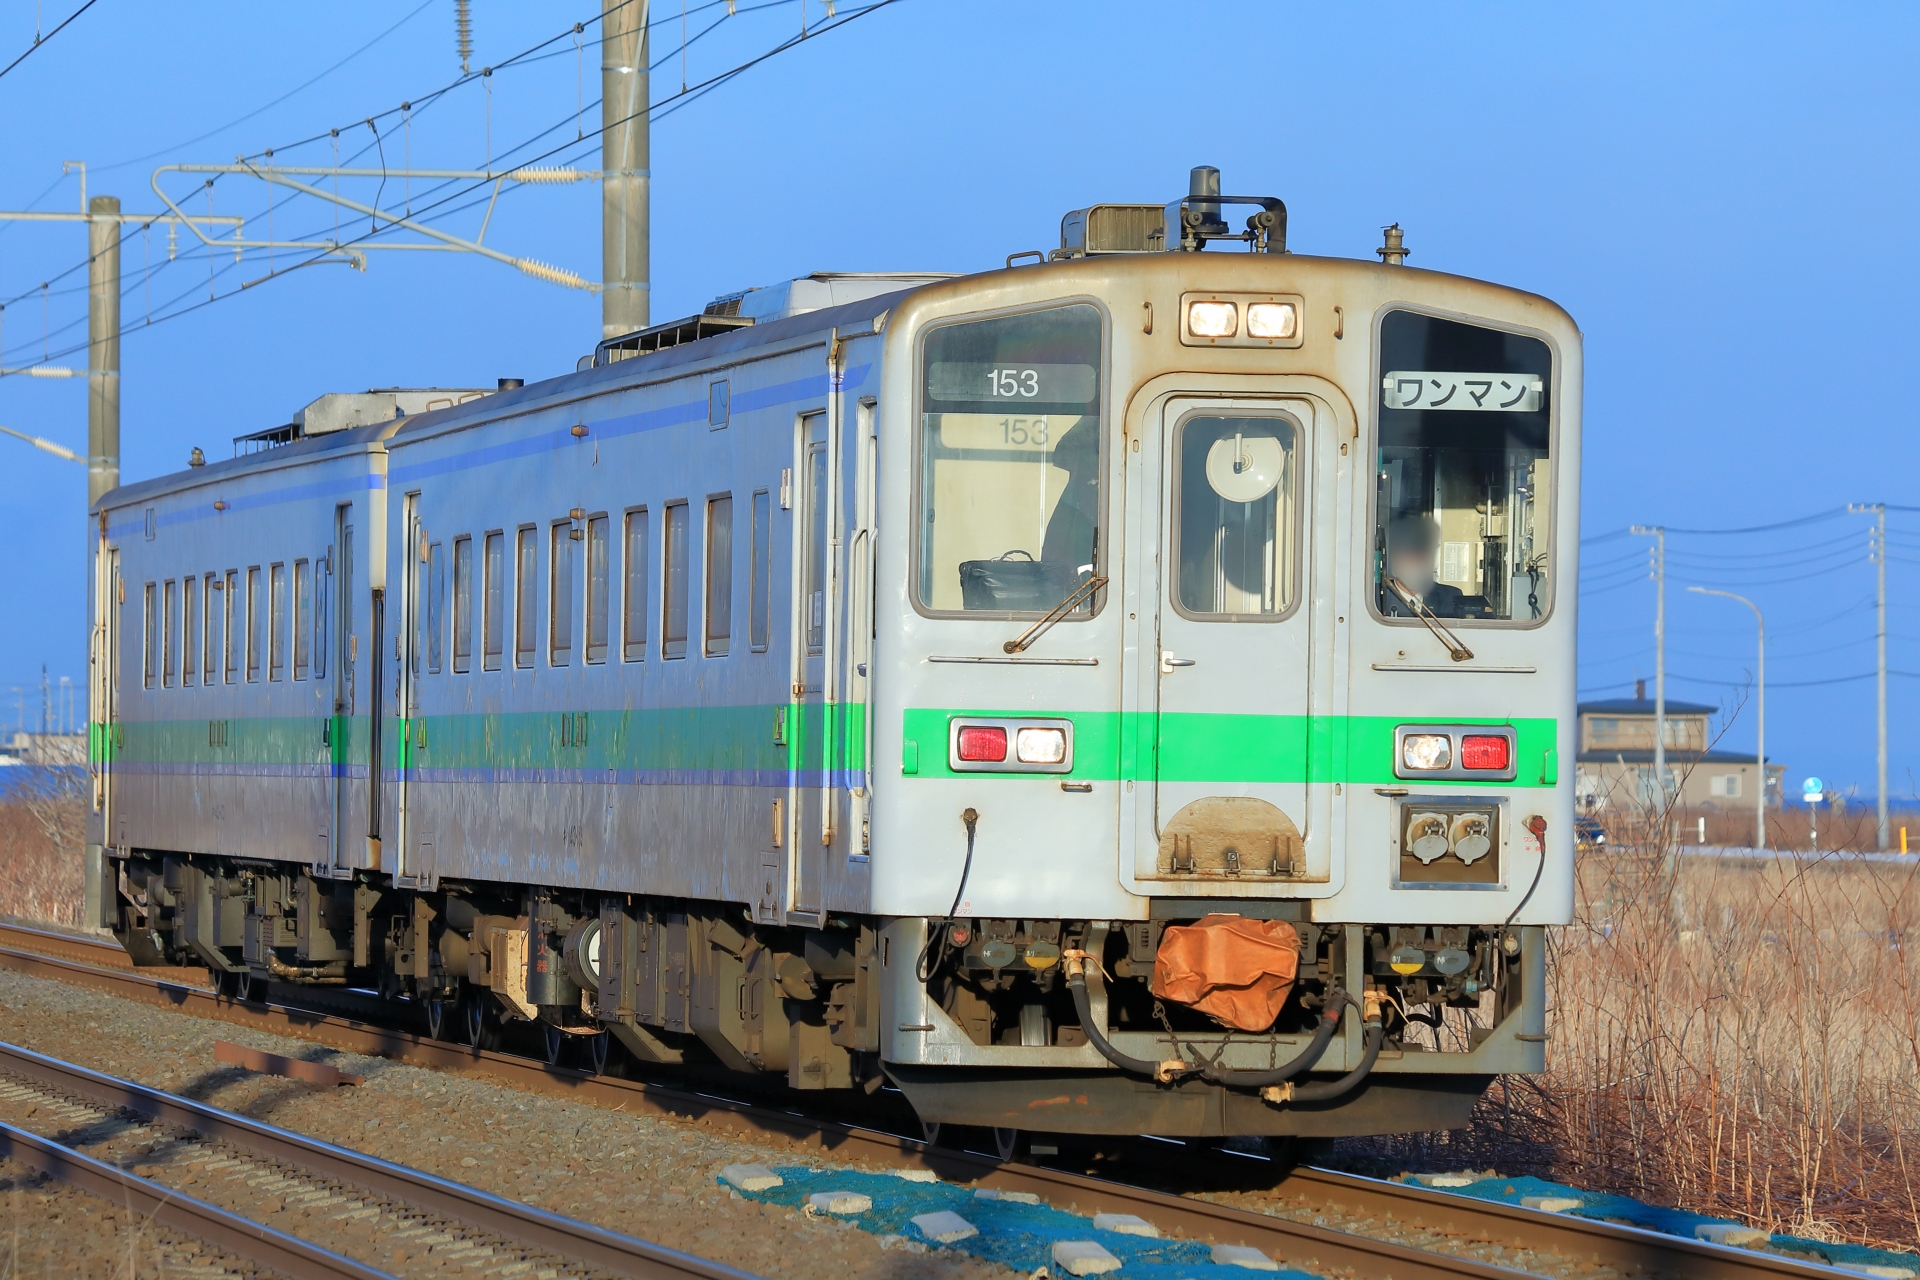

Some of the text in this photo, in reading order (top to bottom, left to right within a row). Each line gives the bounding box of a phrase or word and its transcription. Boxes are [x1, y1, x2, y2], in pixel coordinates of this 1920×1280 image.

[987, 369, 1039, 397] 153
[1397, 378, 1528, 409] ワンマン
[999, 418, 1049, 446] 153
